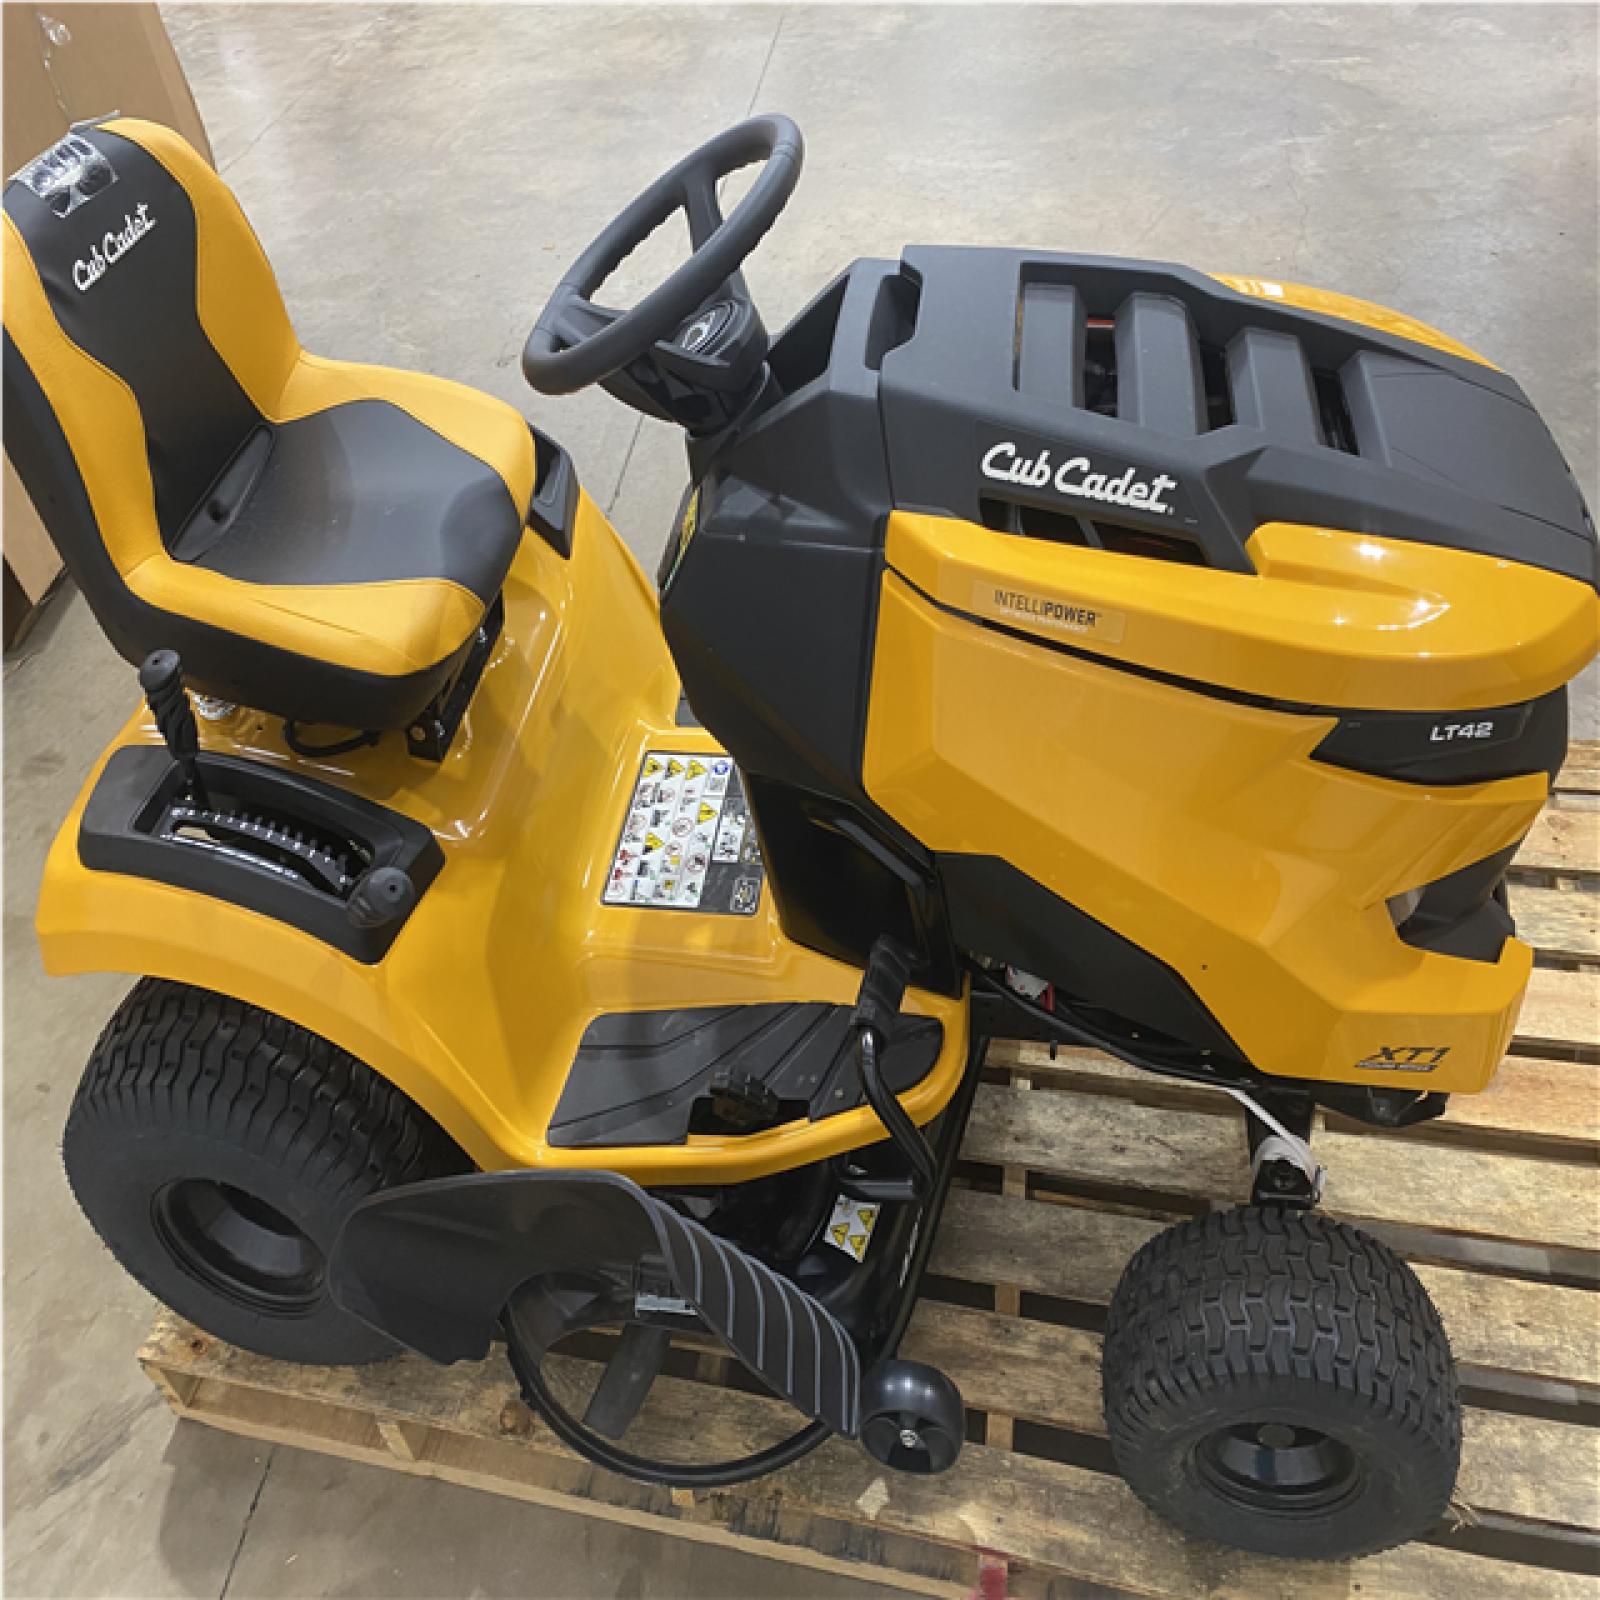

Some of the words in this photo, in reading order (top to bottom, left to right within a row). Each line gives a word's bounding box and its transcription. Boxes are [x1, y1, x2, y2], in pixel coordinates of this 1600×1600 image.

[72, 244, 105, 291] Cub
[102, 203, 156, 264] Cadet
[981, 442, 1051, 487] Cub
[1054, 457, 1178, 514] Cadet
[1429, 721, 1494, 741] LT42
[1362, 1046, 1451, 1064] XT1
